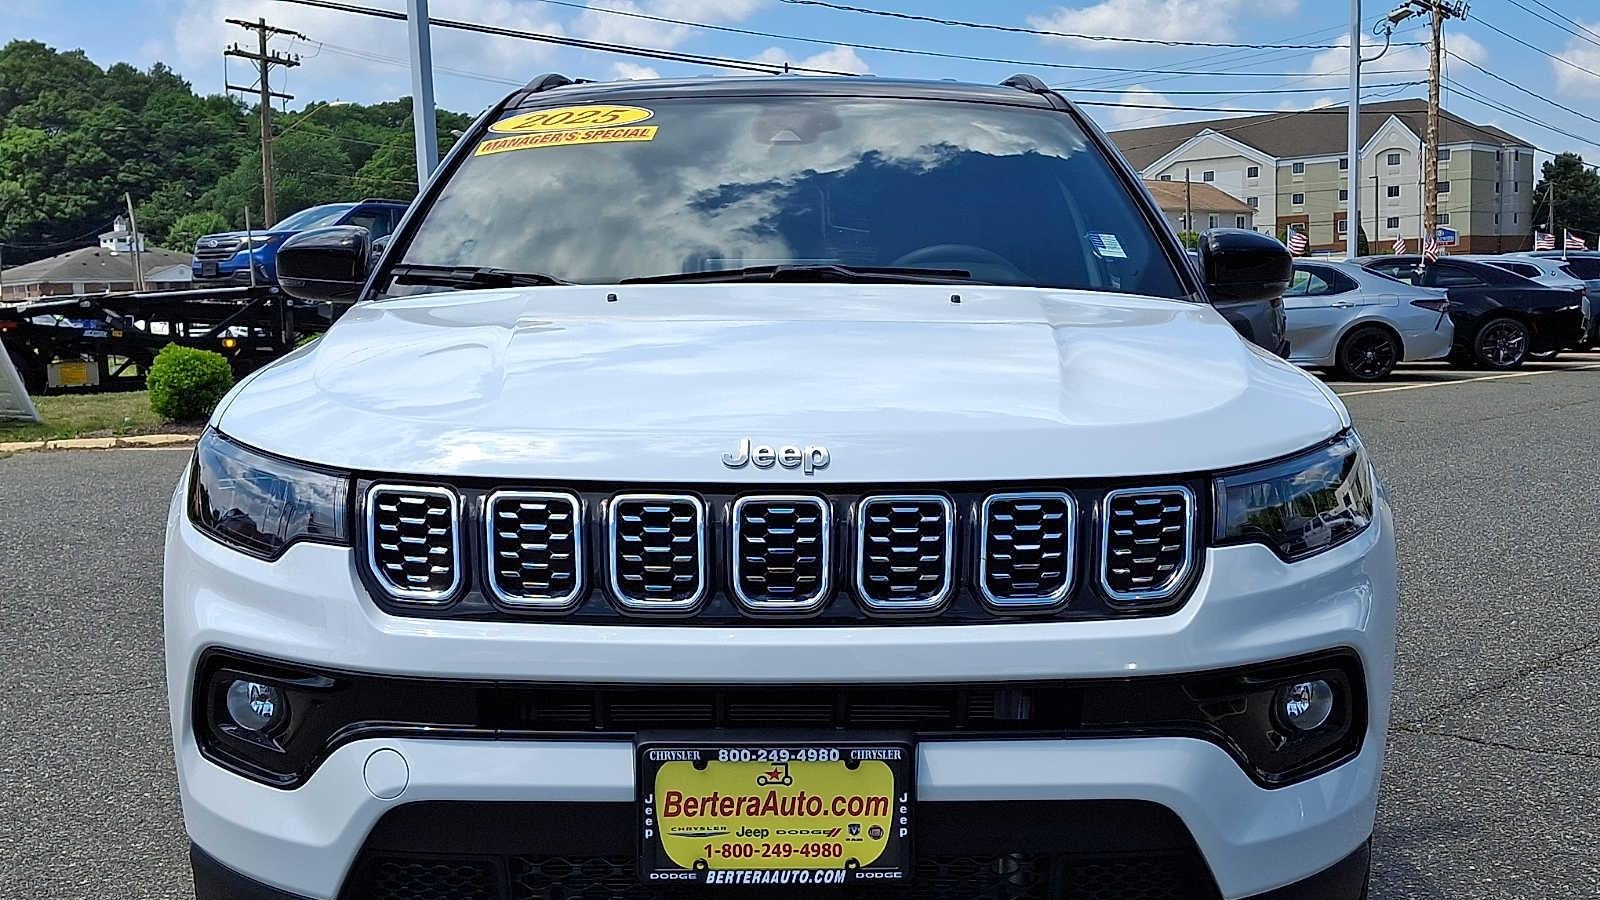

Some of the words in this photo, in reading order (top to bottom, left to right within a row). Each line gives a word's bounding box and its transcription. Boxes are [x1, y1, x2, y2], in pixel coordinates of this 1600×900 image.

[512, 109, 631, 130] 2025
[481, 132, 576, 152] MANAGER'S
[581, 128, 650, 140] SPECIAL
[721, 437, 831, 475] Jeep
[649, 750, 701, 761] CHRYSLER
[718, 749, 840, 762] 800-249-4980
[850, 749, 902, 760] CHRYSLER
[663, 790, 889, 818] BerteraAuto.com
[644, 793, 654, 839] Jeep
[899, 792, 909, 838] Jeep
[735, 826, 770, 839] Jeep
[704, 843, 843, 858] 1-800-249-4980
[649, 872, 697, 880] DODGE
[705, 870, 847, 884] BERTERAAUTO.COM
[855, 871, 903, 879] DODGE
